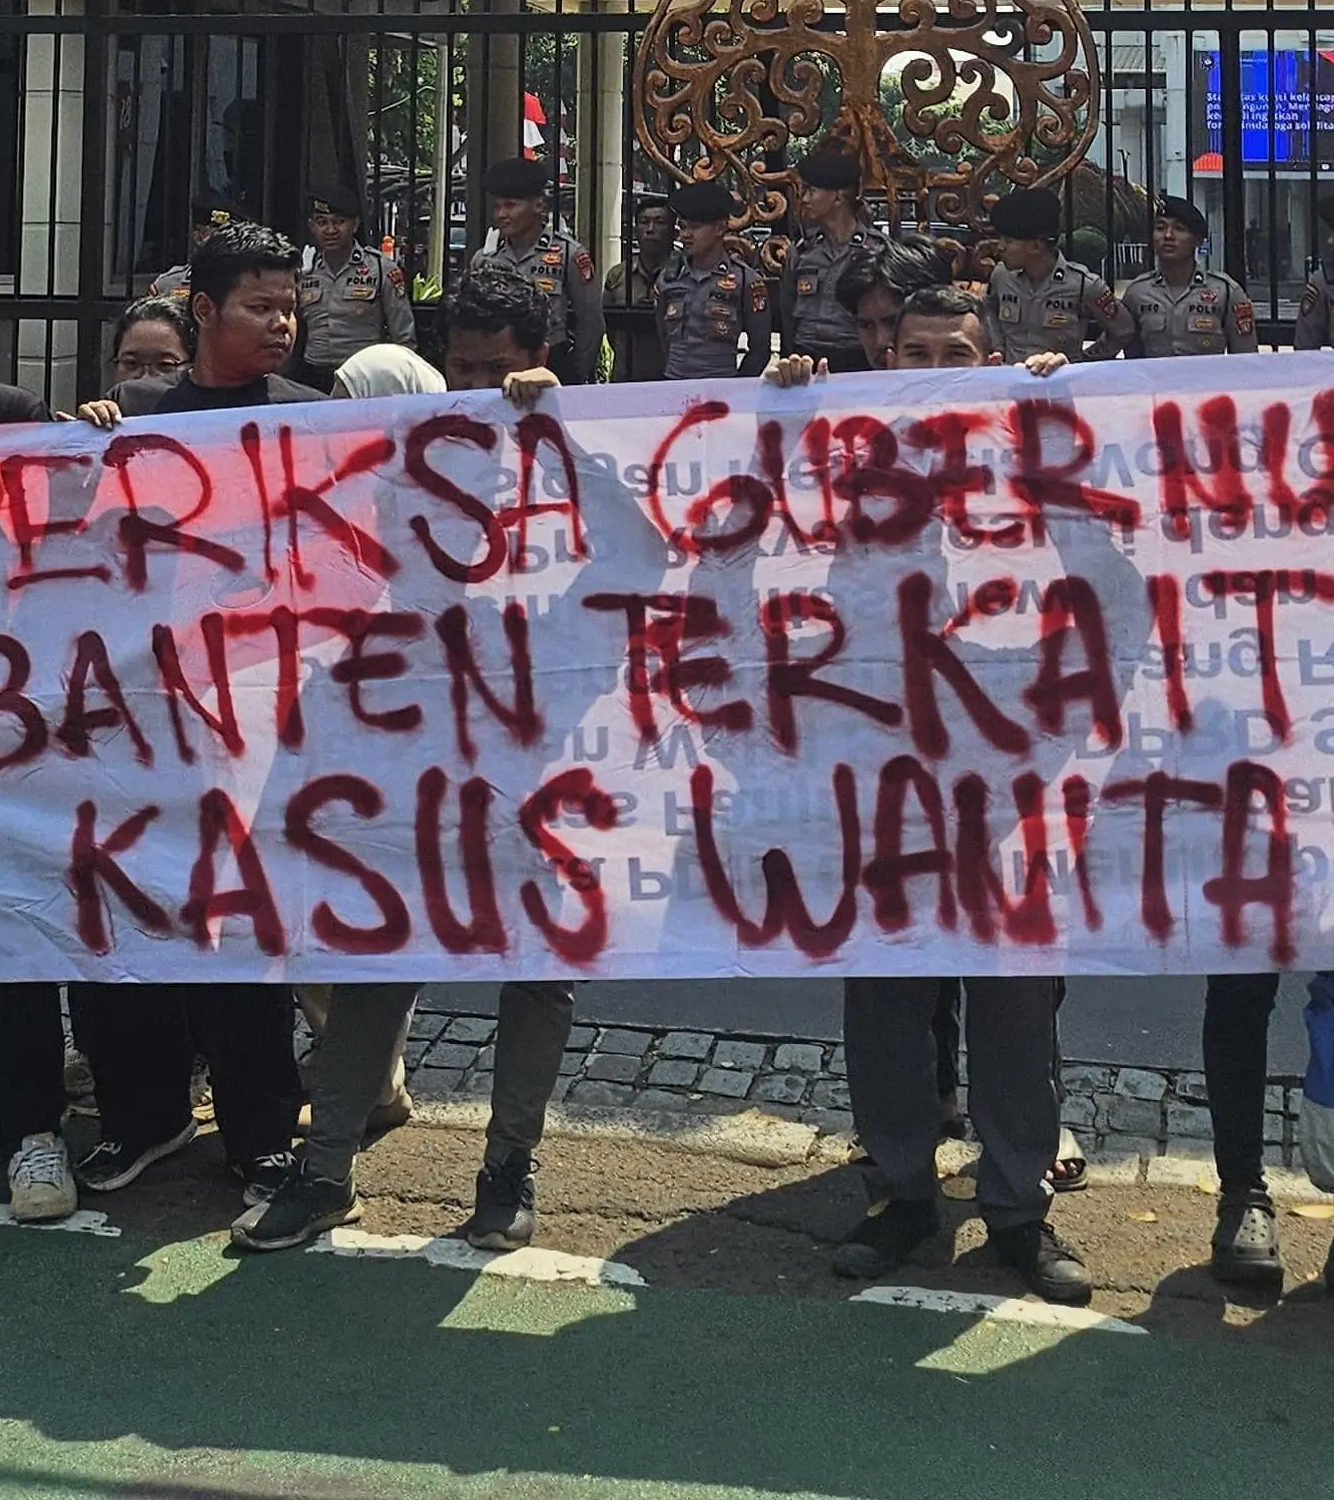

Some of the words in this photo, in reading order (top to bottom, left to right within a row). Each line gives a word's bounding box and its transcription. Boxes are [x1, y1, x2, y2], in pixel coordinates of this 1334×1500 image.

[531, 266, 563, 276] POLRI
[347, 276, 378, 285] POLRI
[69, 762, 618, 966] KASUS
